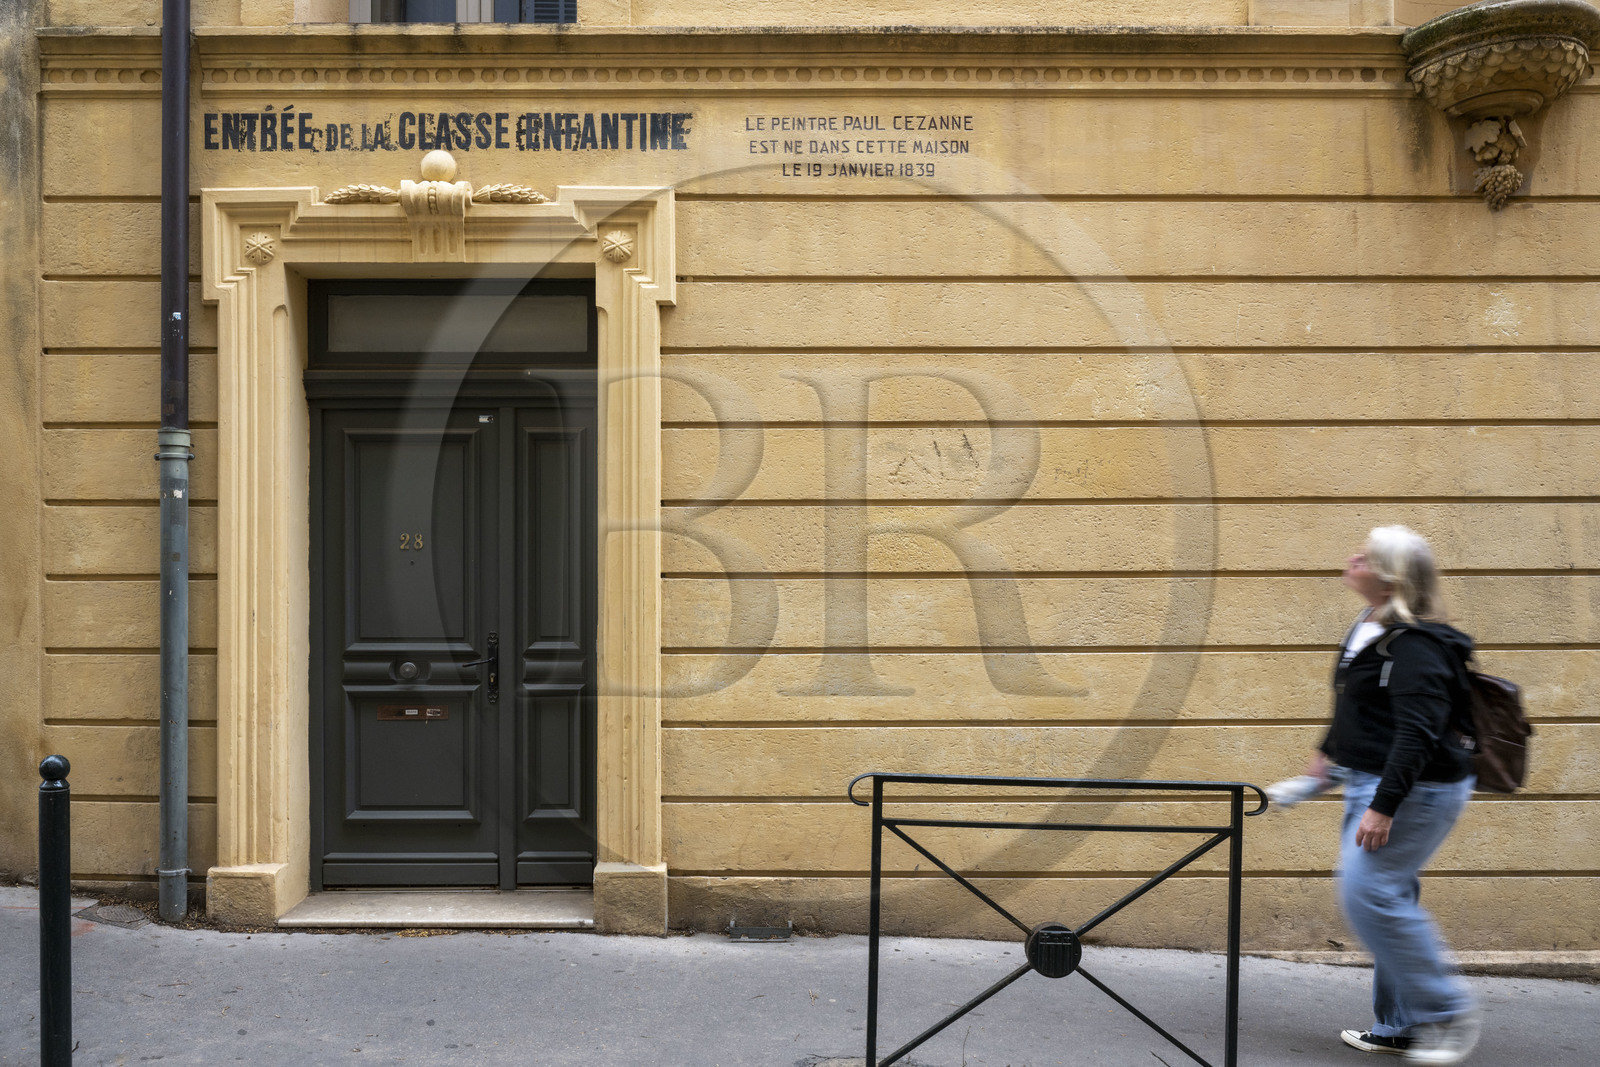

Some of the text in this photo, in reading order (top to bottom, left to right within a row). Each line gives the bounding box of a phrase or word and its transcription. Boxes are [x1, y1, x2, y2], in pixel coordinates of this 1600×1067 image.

[204, 104, 688, 150] ENTRÉE DE LA CLASSE ENFANTINE
[745, 116, 974, 131] LE PEINTRE PAUL CEZANNE
[750, 140, 969, 154] EST NE DANS CETTE MAISON
[782, 163, 935, 177] LE 19 JANVIER 1839
[400, 533, 423, 550] 28
